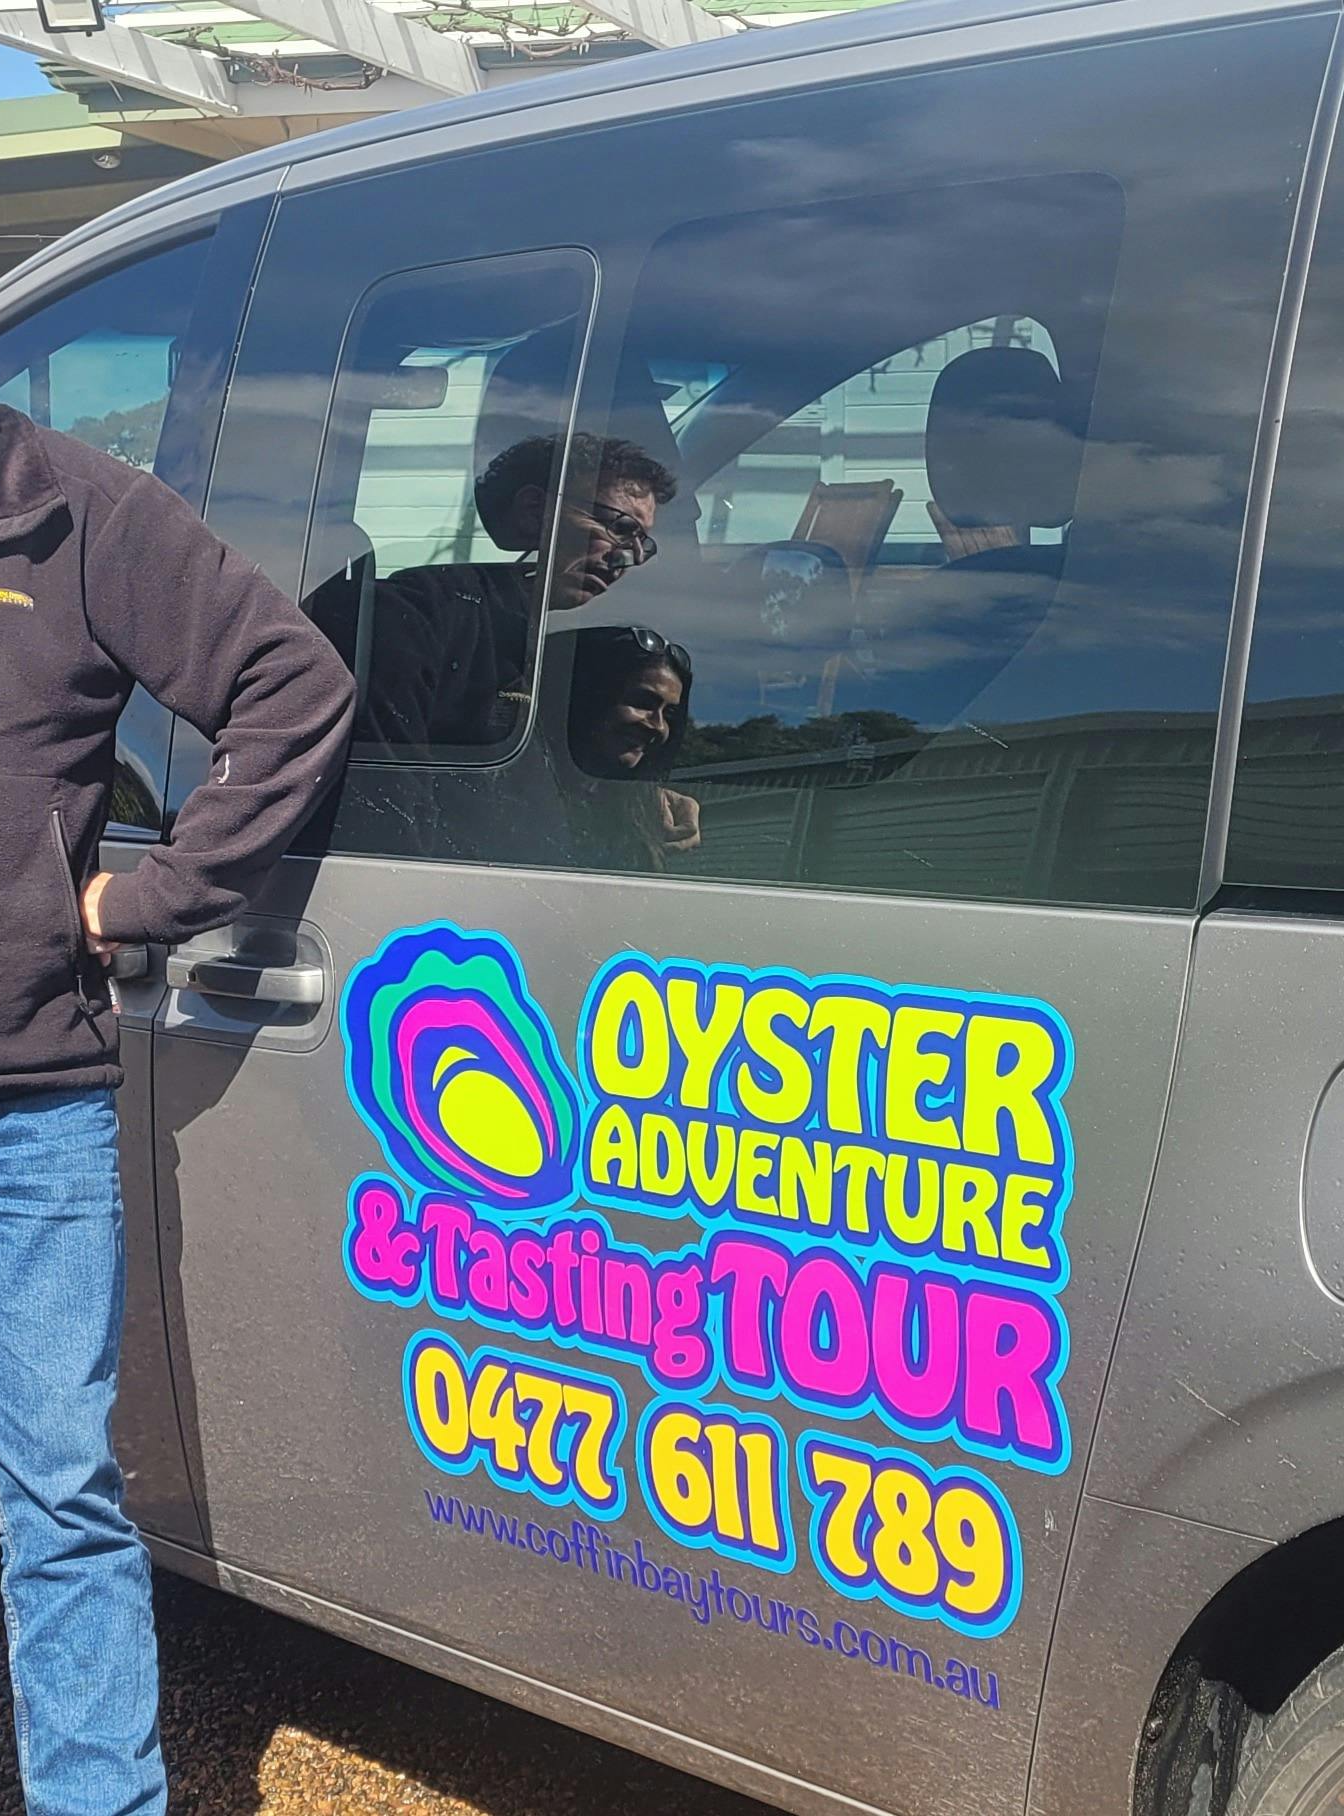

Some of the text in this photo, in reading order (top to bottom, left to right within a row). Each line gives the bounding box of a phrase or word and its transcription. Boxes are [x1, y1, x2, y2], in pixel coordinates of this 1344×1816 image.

[592, 971, 1055, 1164] OYSTER
[591, 1105, 1053, 1268] ADVENTURE
[710, 1240, 1055, 1451] TOUR
[414, 1347, 1004, 1614] 0477 611 789
[423, 1488, 1001, 1709] www.coffinbaytours.com.au
